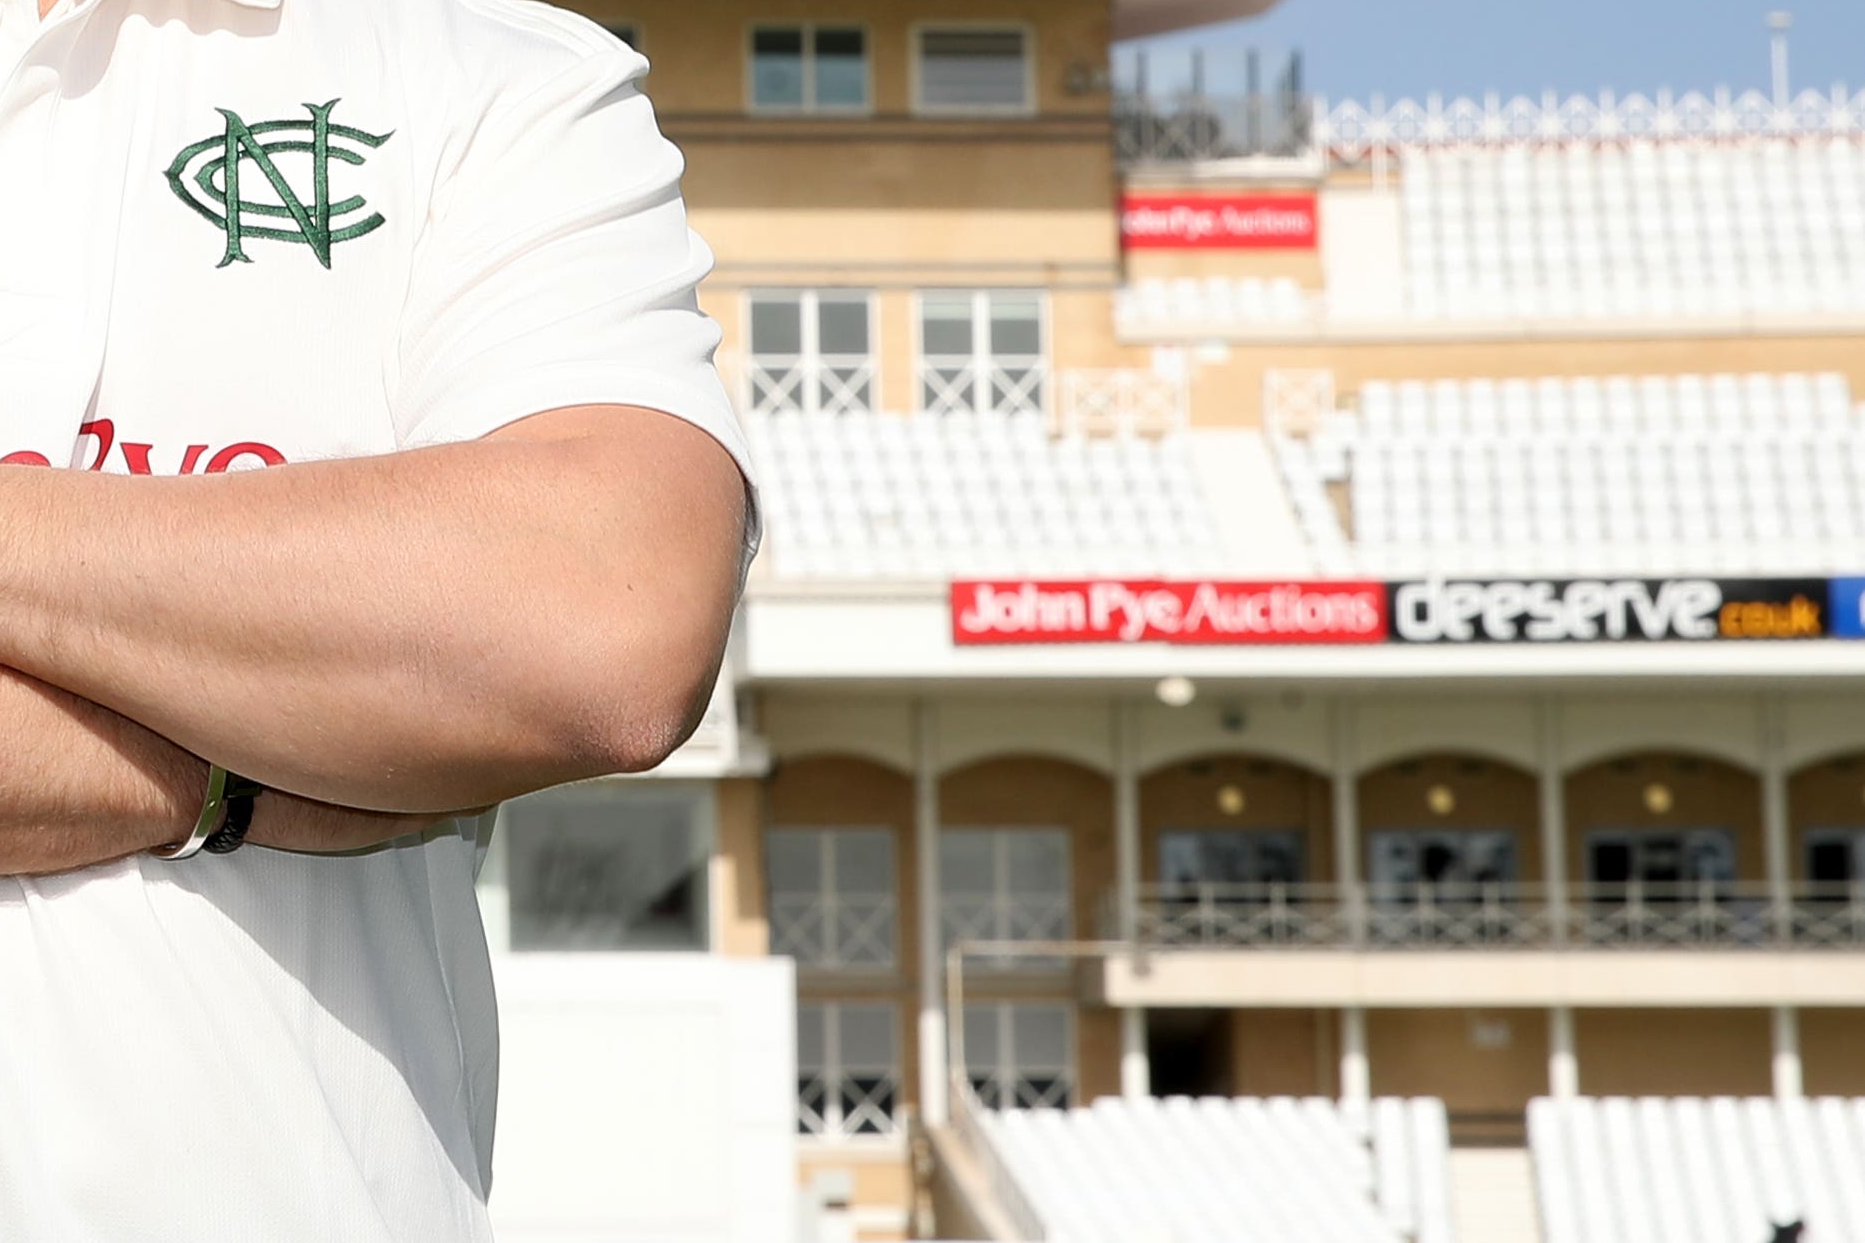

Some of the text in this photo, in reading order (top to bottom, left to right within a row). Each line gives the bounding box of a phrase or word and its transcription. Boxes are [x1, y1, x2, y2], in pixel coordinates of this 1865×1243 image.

[1121, 207, 1168, 236] ohn
[960, 583, 1380, 642] John Pye Auctions
